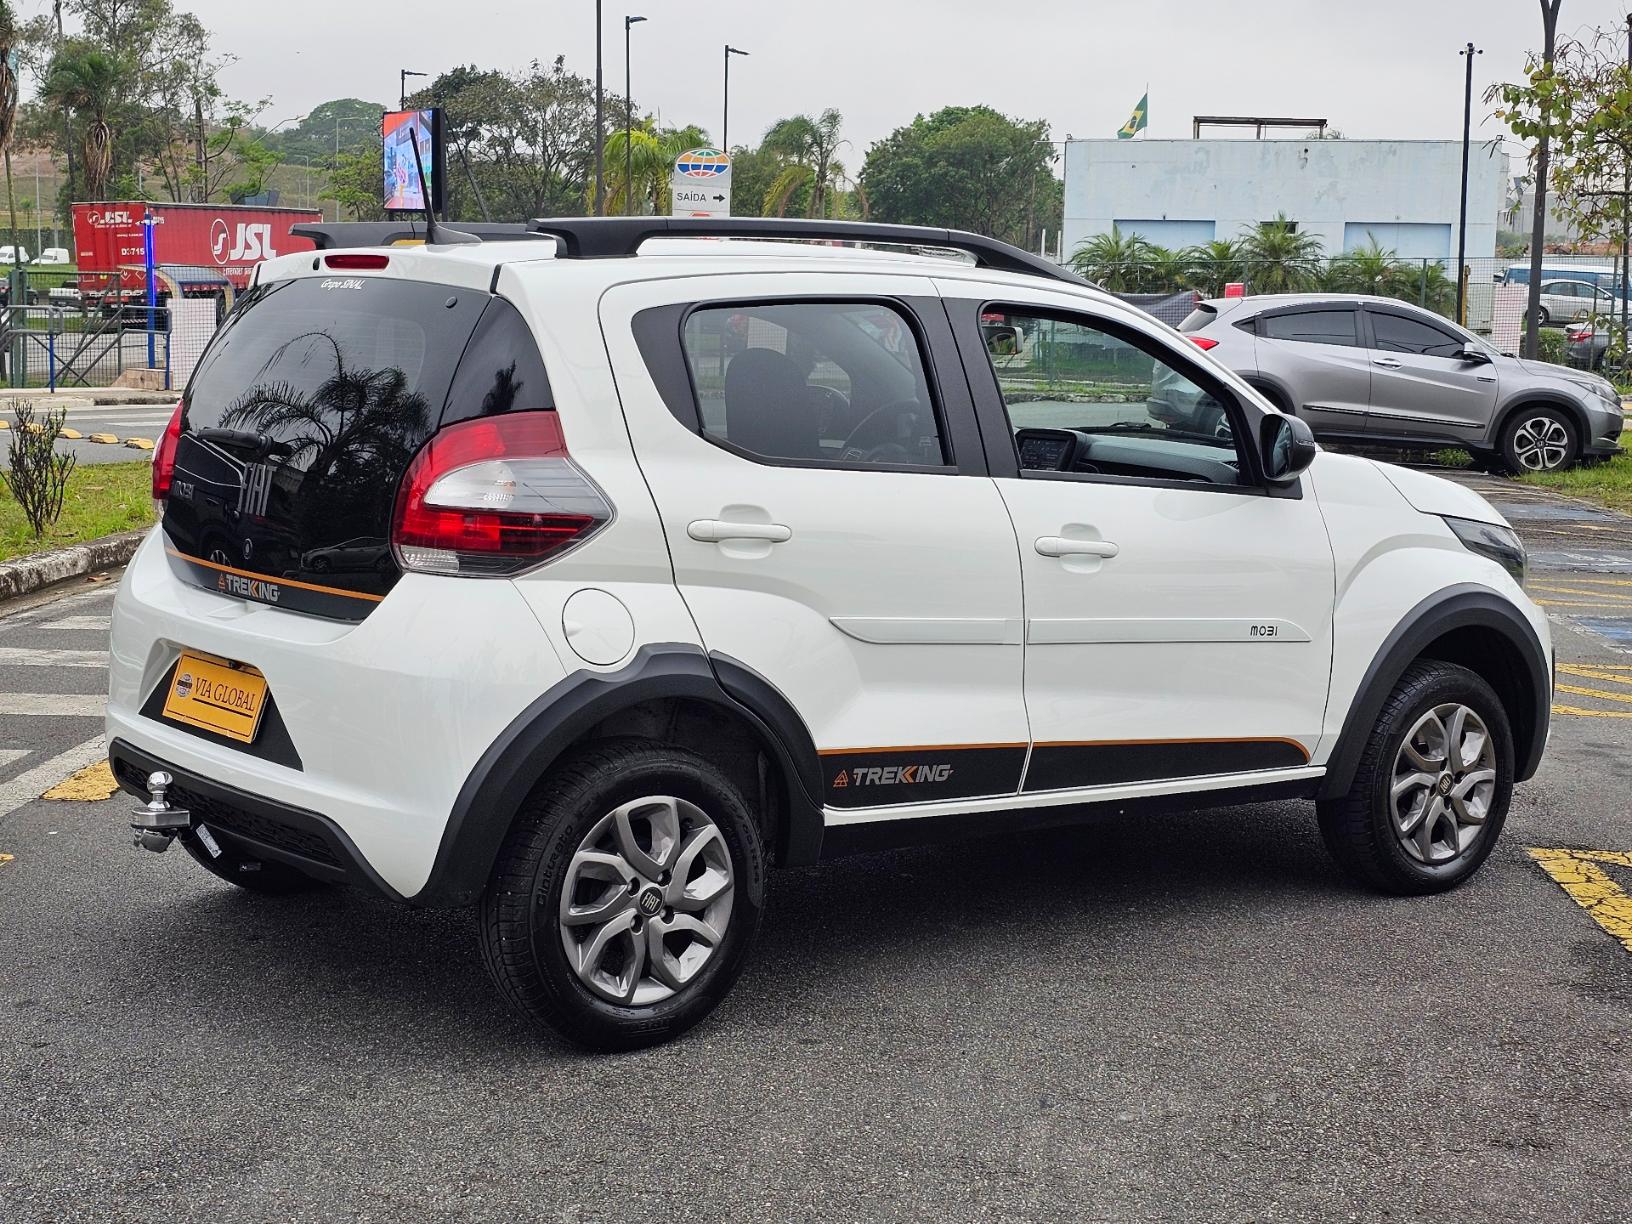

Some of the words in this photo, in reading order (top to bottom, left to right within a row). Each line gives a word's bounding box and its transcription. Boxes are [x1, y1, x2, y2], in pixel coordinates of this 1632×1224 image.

[677, 190, 707, 202] SAÍDA
[229, 223, 277, 260] JSL
[320, 278, 342, 290] Grupo
[340, 279, 366, 290] SINAL
[238, 462, 278, 516] FIAT
[225, 574, 281, 602] TREKKING
[1250, 625, 1278, 636] MOBI
[194, 677, 212, 697] VIA
[214, 683, 257, 712] GLOBAL
[853, 764, 954, 786] TREKKING
[641, 891, 661, 911] FIAT
